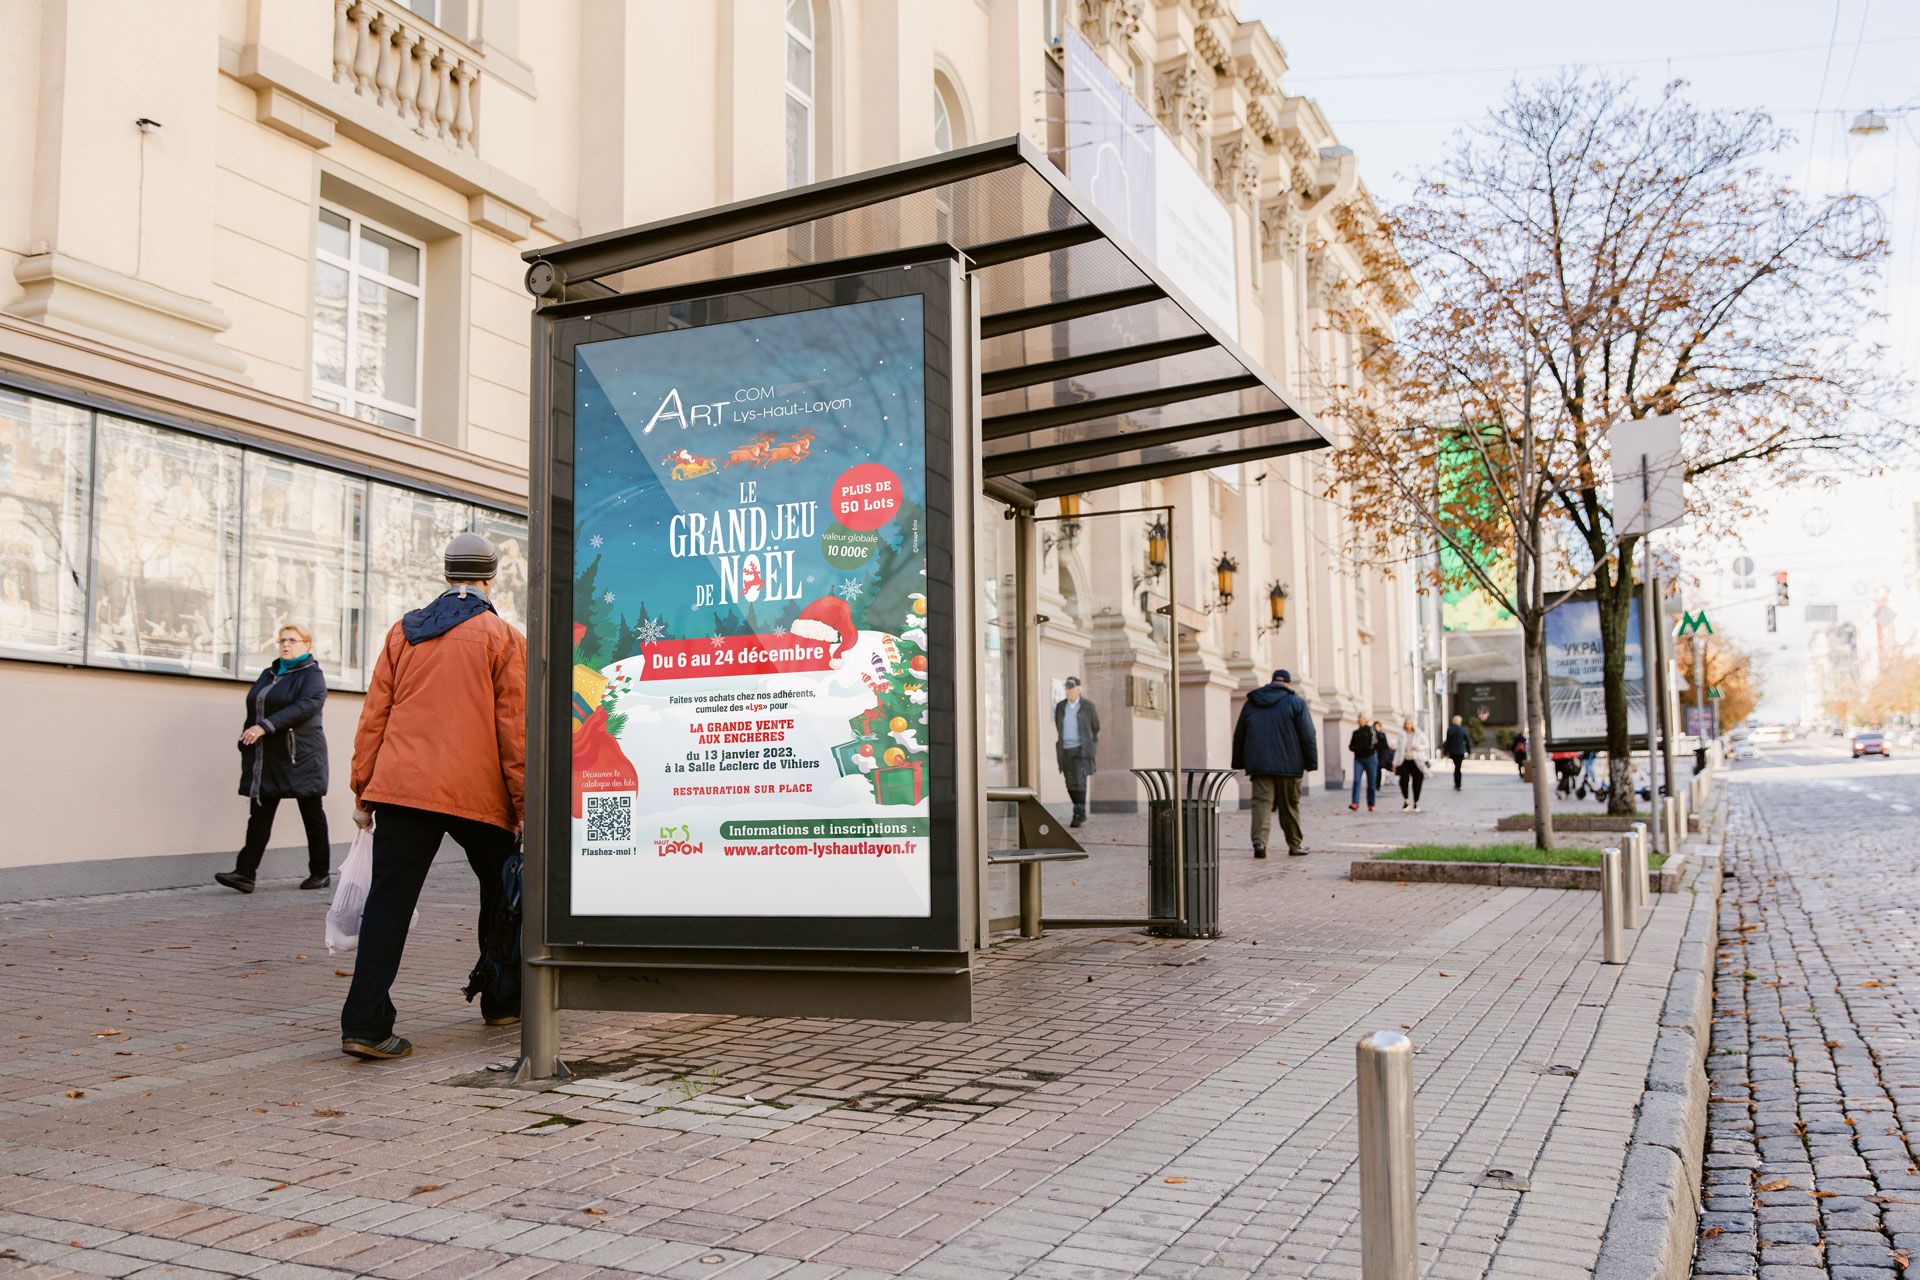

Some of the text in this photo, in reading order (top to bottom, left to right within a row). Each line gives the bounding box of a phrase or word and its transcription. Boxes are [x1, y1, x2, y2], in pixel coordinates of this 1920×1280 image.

[642, 388, 731, 436] ART
[733, 398, 852, 423] Lys-Haut-Layon
[739, 481, 757, 504] LE
[842, 481, 892, 497] PLUS DE
[841, 498, 895, 514] 50 Lots
[669, 501, 817, 558] GRAND JEU
[822, 533, 878, 543] valeur globale
[828, 545, 869, 558] 10 000€
[696, 545, 803, 607] DE NOËL
[652, 644, 824, 670] Du 6 au 24 décembre
[669, 689, 816, 705] Faites vos achats chez nos adhérents,
[695, 702, 788, 714] cumulez des «Lys» pour
[690, 719, 794, 733] LA GRANDE VENTE
[698, 729, 785, 744] AUX ENCHÈRES
[686, 750, 700, 761] du
[704, 750, 718, 760] 13
[721, 748, 760, 761] janvier
[664, 758, 820, 773] à la Salle Leclerc de Vihiers
[623, 779, 636, 787] lots
[672, 783, 813, 796] RESTAURATION SUR PLACE
[729, 824, 809, 837] Informations
[813, 824, 825, 835] et
[829, 822, 908, 837] inscriptions
[581, 847, 631, 857] Flashez-moi
[658, 840, 703, 857] LAYON
[723, 840, 917, 858] www.artcom-lyshautlayon.fr
